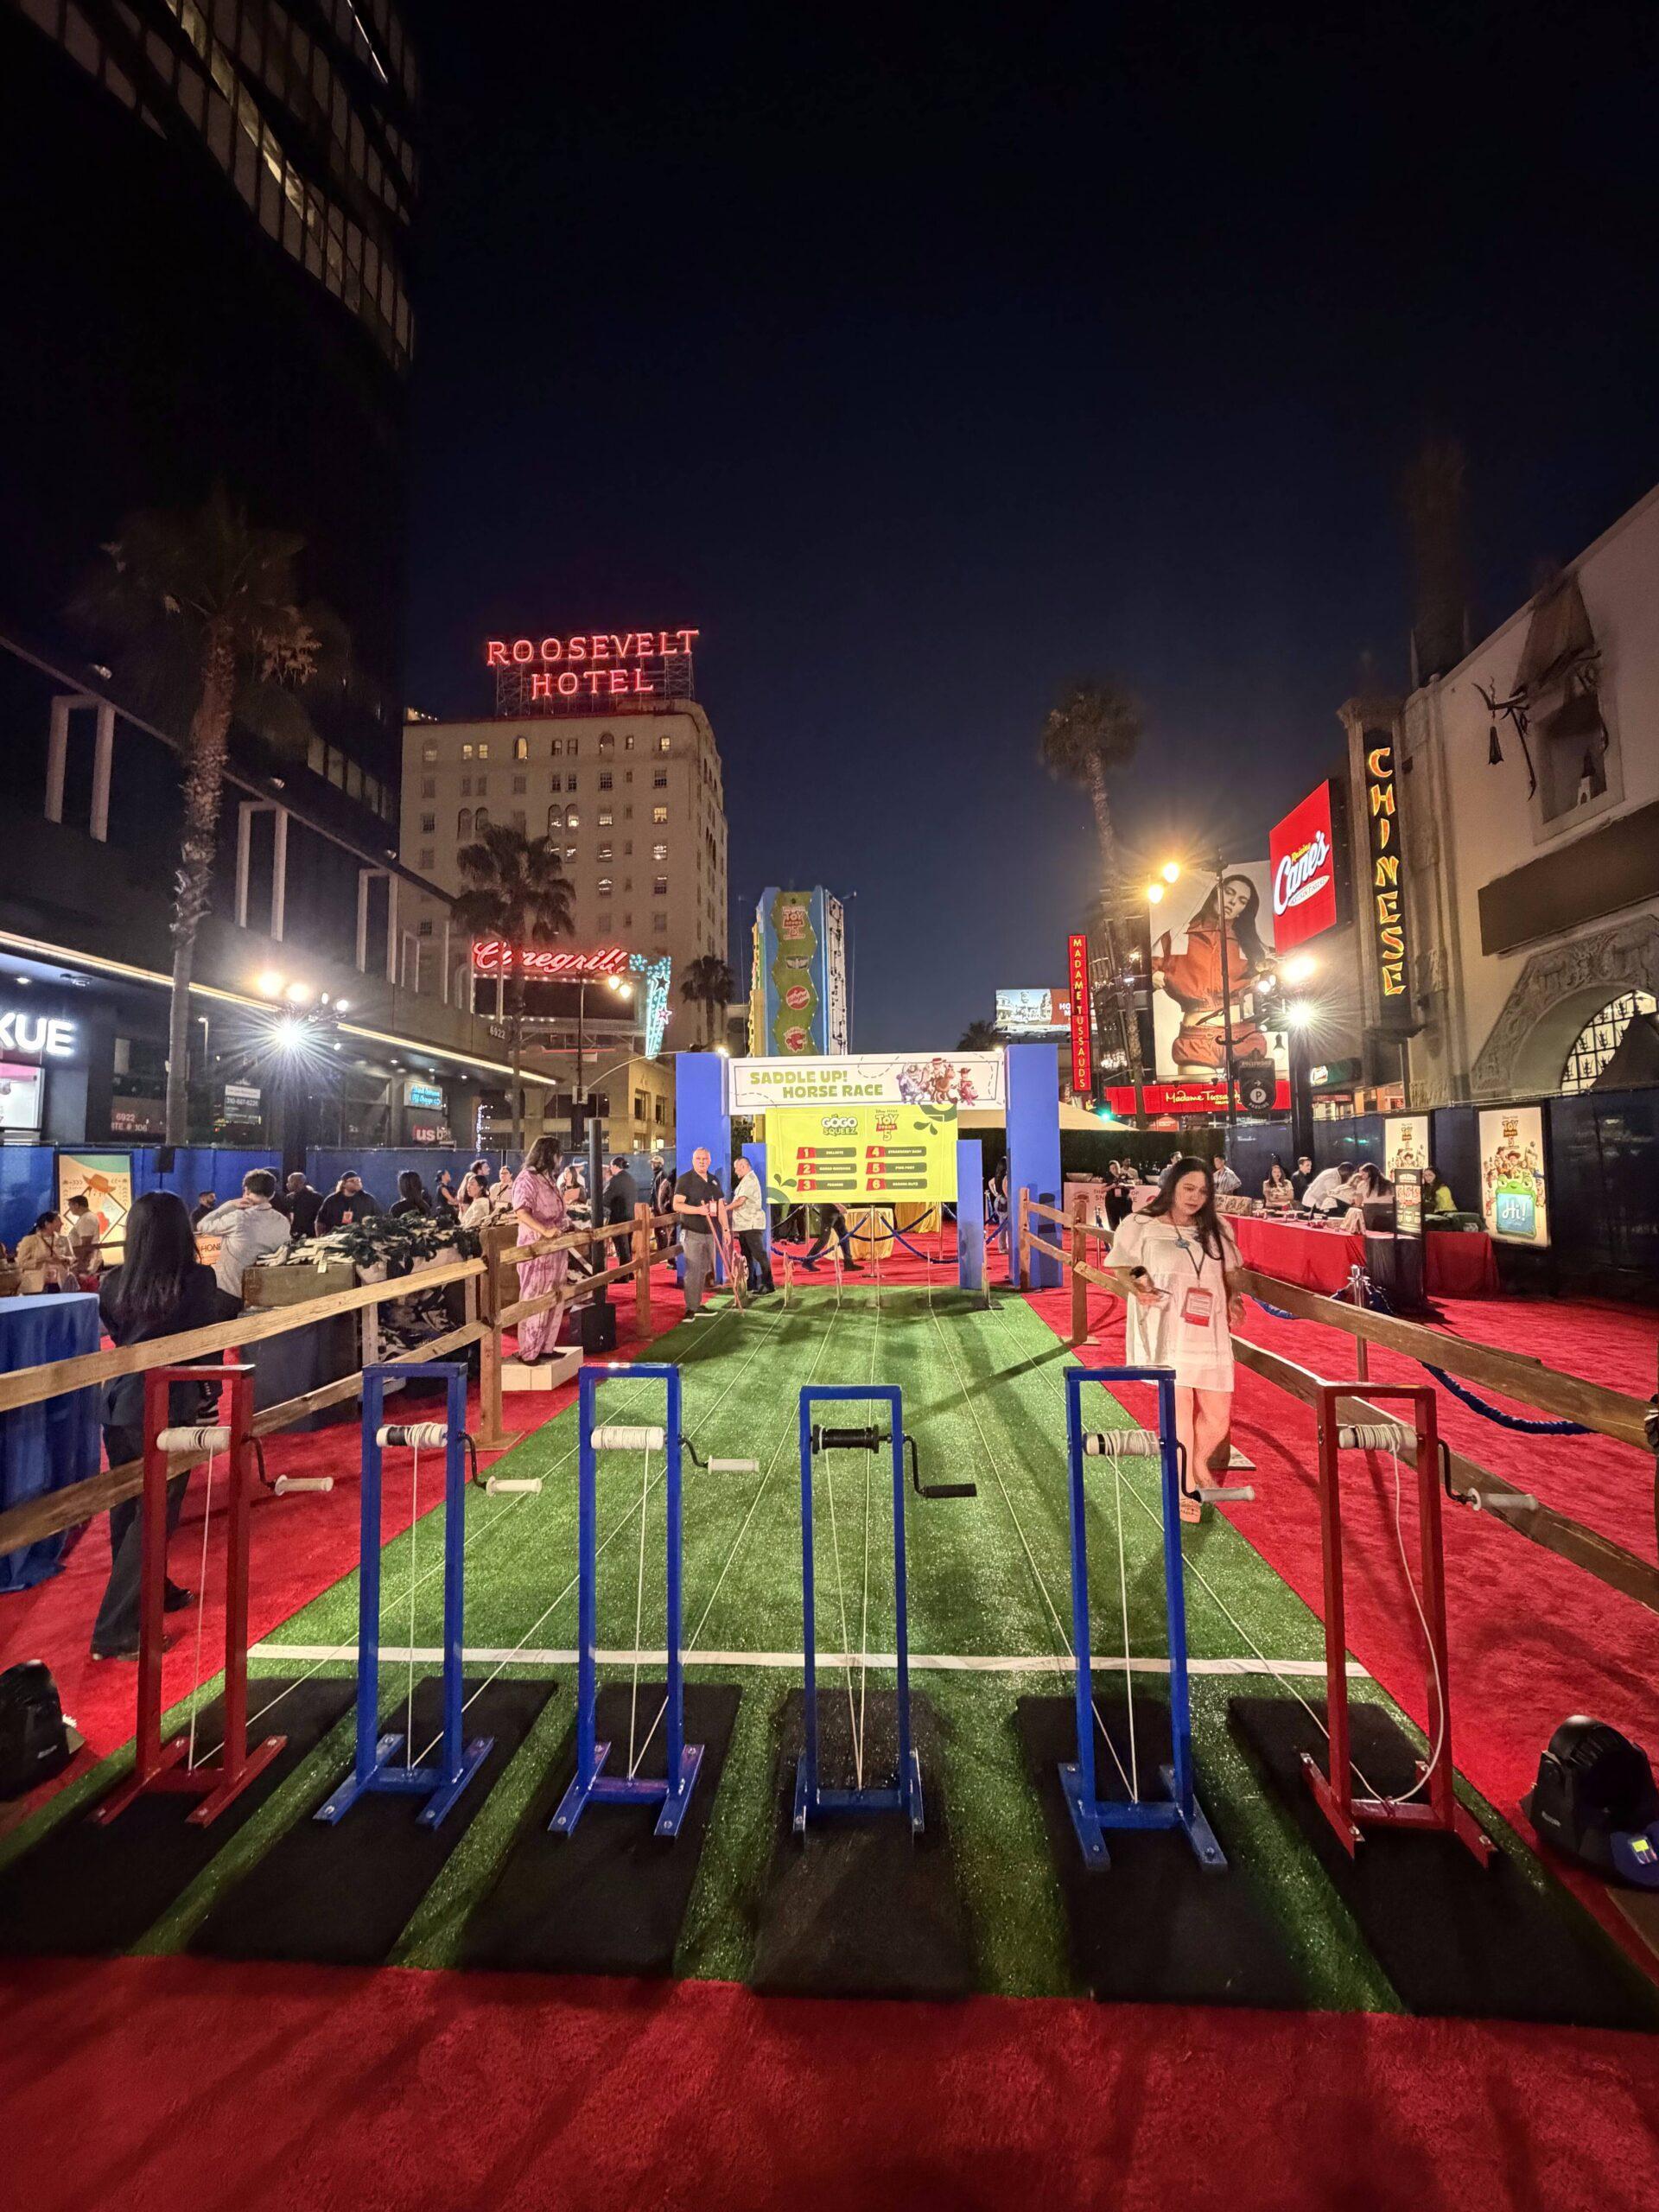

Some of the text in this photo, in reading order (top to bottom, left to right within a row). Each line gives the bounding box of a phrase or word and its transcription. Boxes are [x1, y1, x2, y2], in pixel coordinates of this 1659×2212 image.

[486, 630, 699, 666] ROOSEVELT
[531, 668, 654, 700] HOTEL
[1274, 830, 1330, 915] Cane's
[1369, 747, 1407, 995] CHINESE
[1073, 938, 1086, 1088] MADAME TUSSAUDS
[490, 1026, 506, 1039] 6922
[750, 1071, 848, 1084] SADDLE UP!
[783, 1084, 883, 1098] HORSE RACE
[1166, 1090, 1205, 1103] Madame
[1255, 1091, 1262, 1102] P
[875, 1114, 898, 1125] TOY
[883, 1130, 892, 1141] 5
[804, 1148, 809, 1158] 1
[872, 1147, 880, 1157] 4
[803, 1164, 810, 1174] 2
[872, 1163, 880, 1173] 5
[803, 1180, 810, 1190] 3
[872, 1179, 880, 1190] 6
[1502, 1200, 1526, 1221] Hi!
